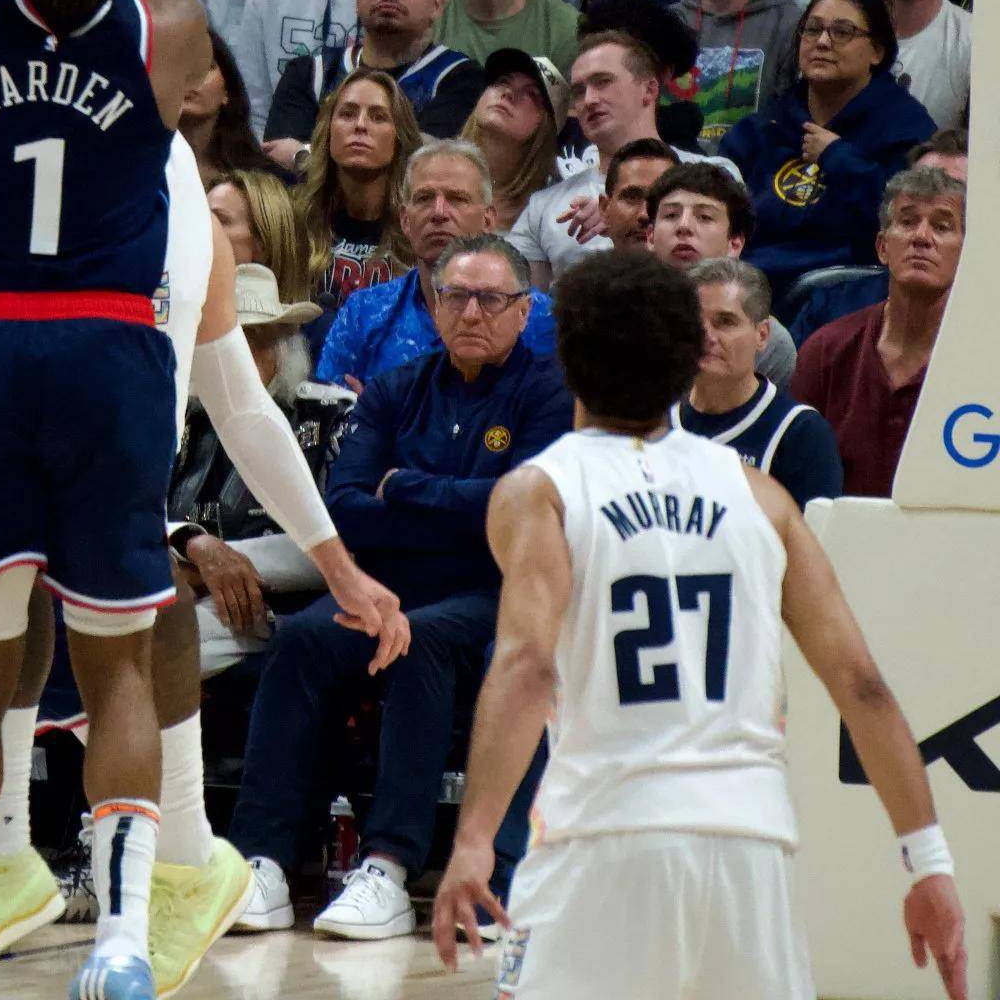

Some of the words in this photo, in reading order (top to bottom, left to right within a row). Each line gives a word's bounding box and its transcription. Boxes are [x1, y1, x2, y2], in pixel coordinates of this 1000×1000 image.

[13, 137, 66, 257] 1
[600, 494, 727, 541] MURRAY
[610, 573, 732, 705] 27
